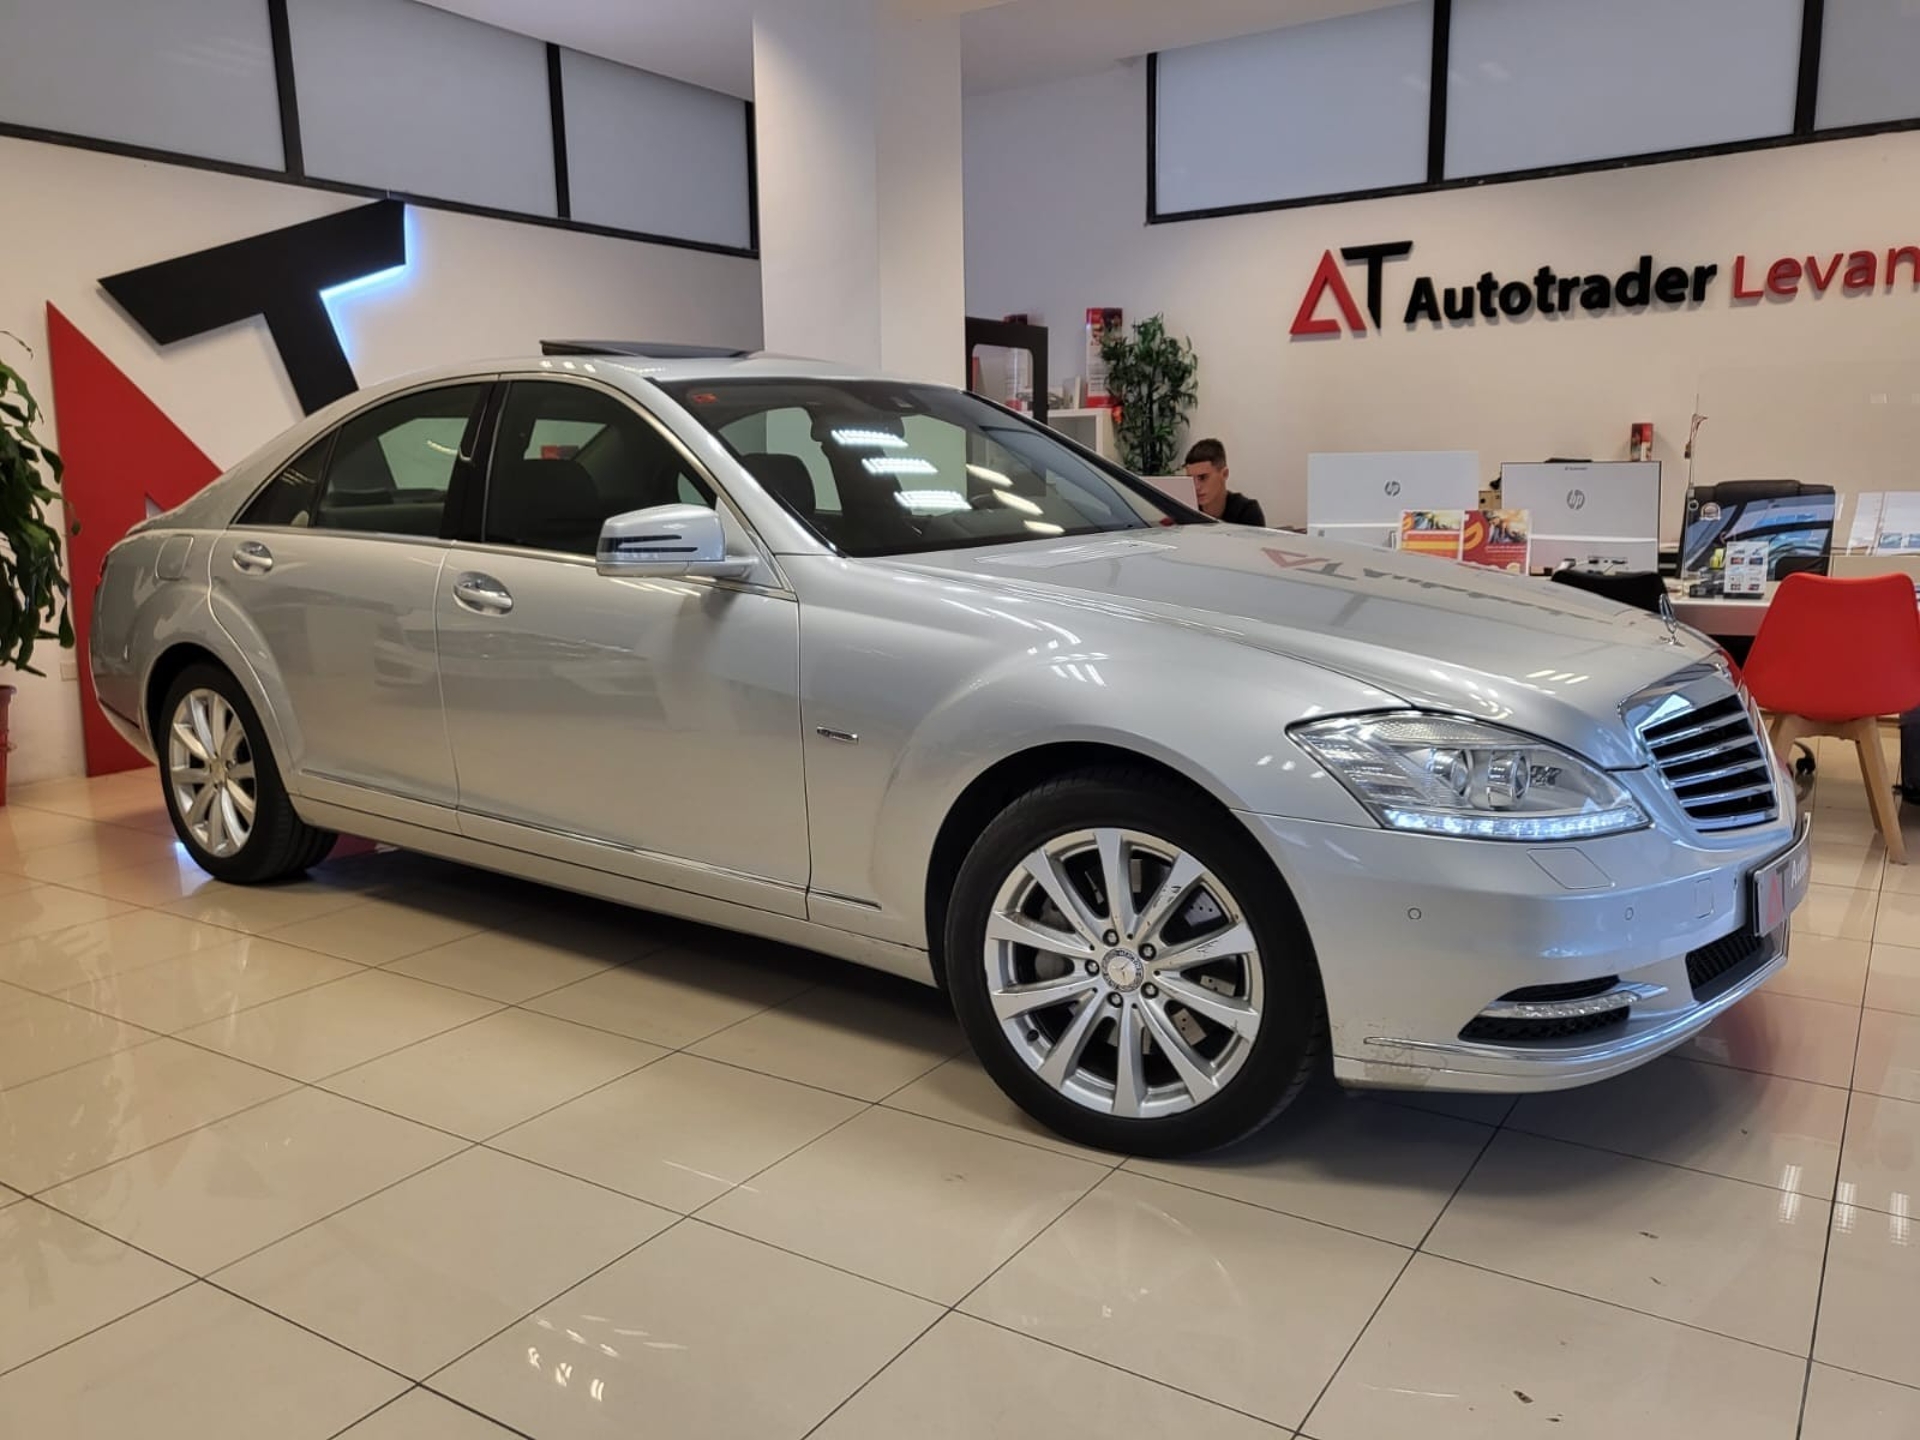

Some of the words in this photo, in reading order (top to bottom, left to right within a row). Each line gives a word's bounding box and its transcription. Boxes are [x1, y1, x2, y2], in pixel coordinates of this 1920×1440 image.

[1289, 240, 1413, 335] AT
[1404, 255, 1718, 324] Autotrader
[1733, 246, 1920, 299] Levan
